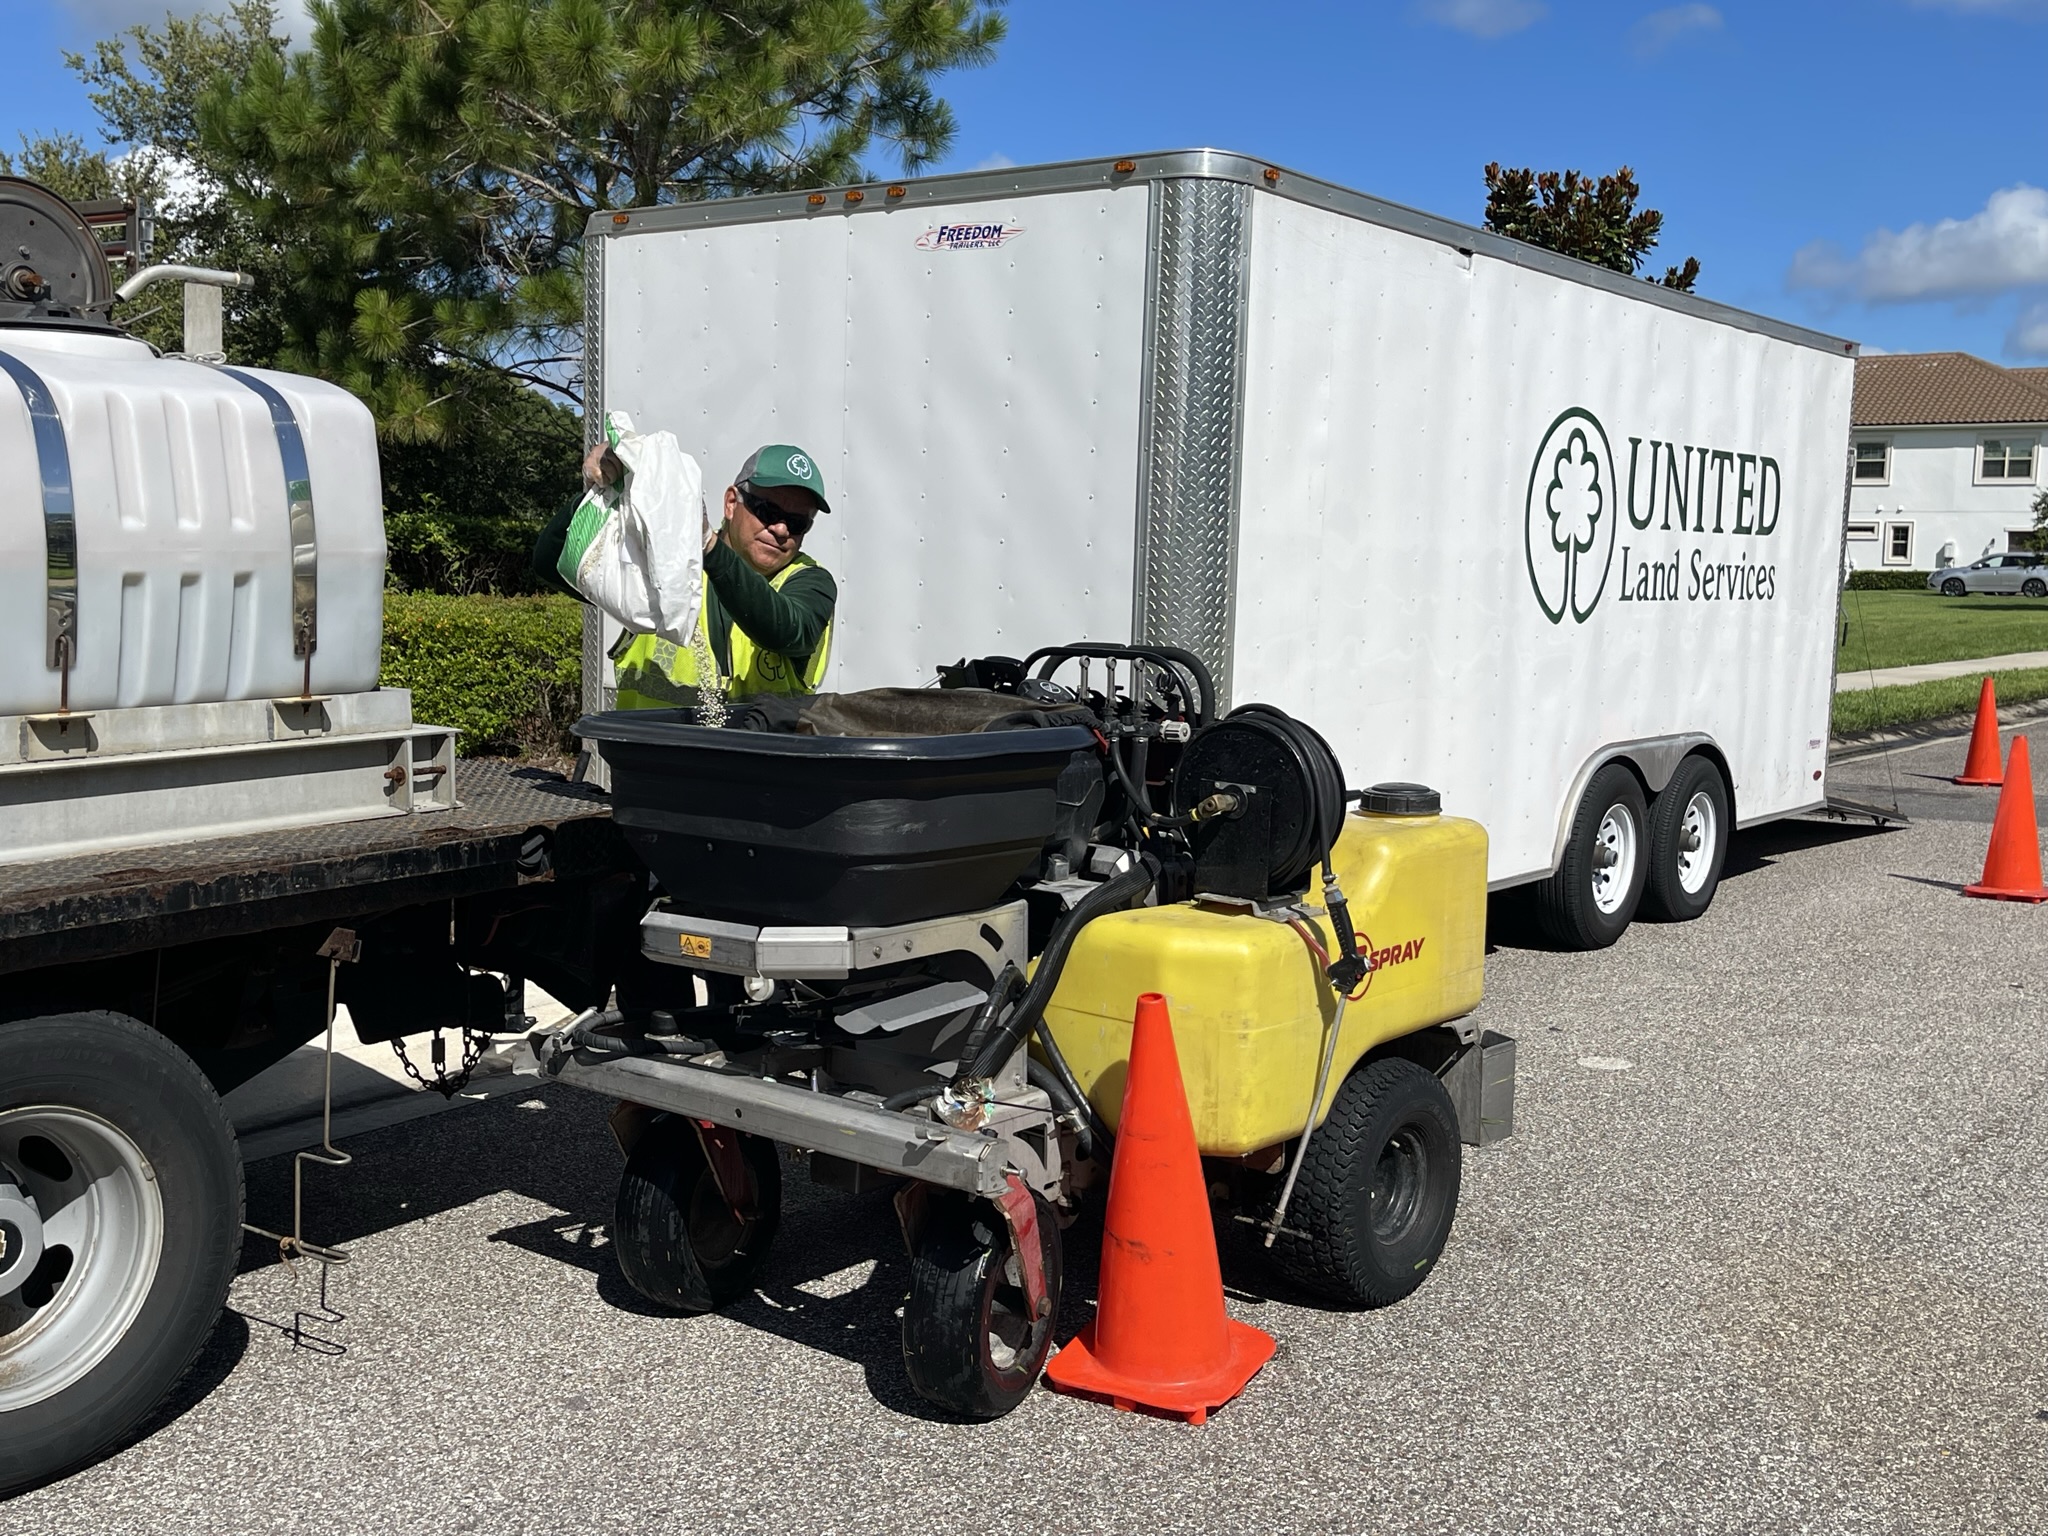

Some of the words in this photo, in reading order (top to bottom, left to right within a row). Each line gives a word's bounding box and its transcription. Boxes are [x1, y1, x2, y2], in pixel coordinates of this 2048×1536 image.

[937, 225, 1003, 244] FREEDOM
[1628, 437, 1781, 536] UNITED
[1619, 546, 1680, 601] Land
[1688, 548, 1775, 601] Services
